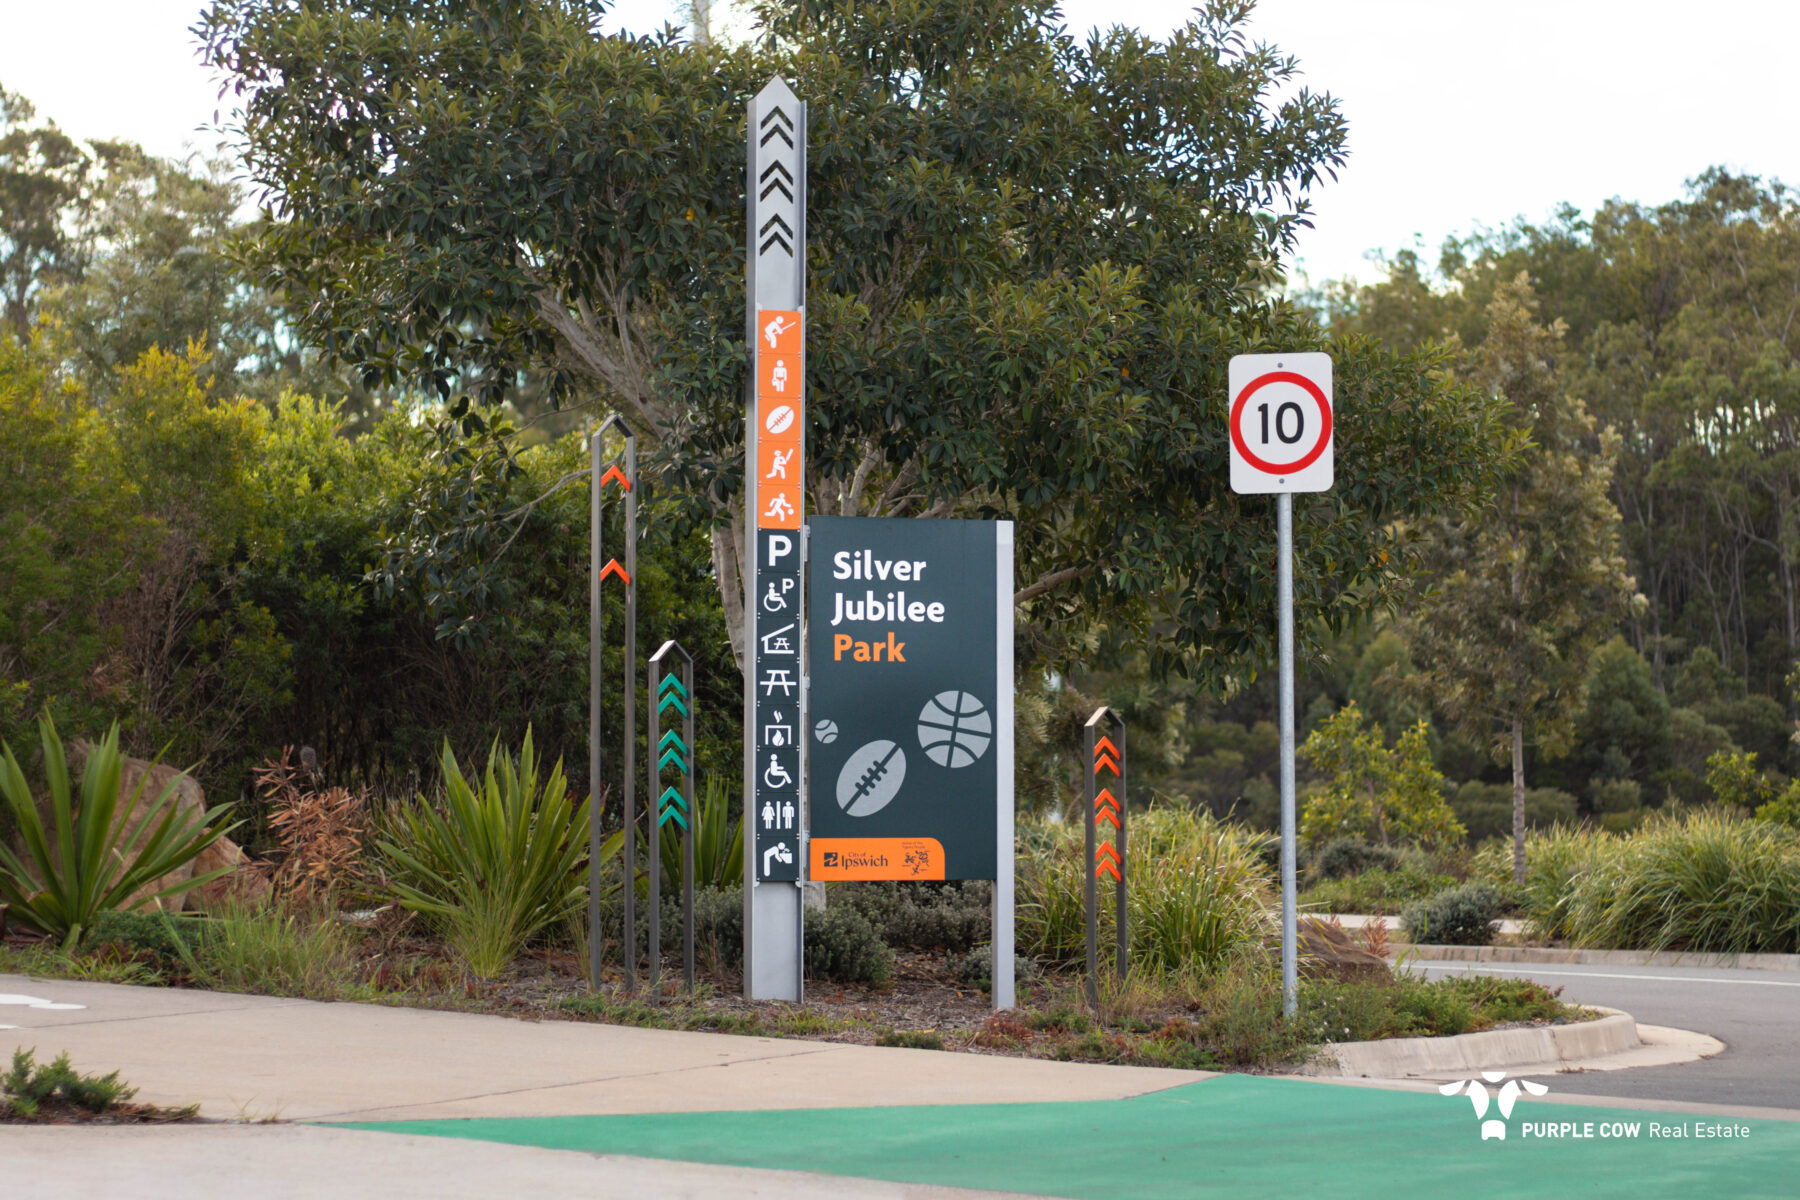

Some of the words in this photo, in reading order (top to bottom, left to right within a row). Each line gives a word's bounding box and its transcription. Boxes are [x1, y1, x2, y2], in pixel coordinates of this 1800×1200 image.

[1258, 402, 1304, 444] 10
[768, 535, 792, 567] P
[833, 549, 926, 581] Silver
[782, 578, 795, 594] P
[831, 591, 945, 627] Jubilee
[833, 632, 907, 662] Park
[841, 854, 889, 870] Ipswich
